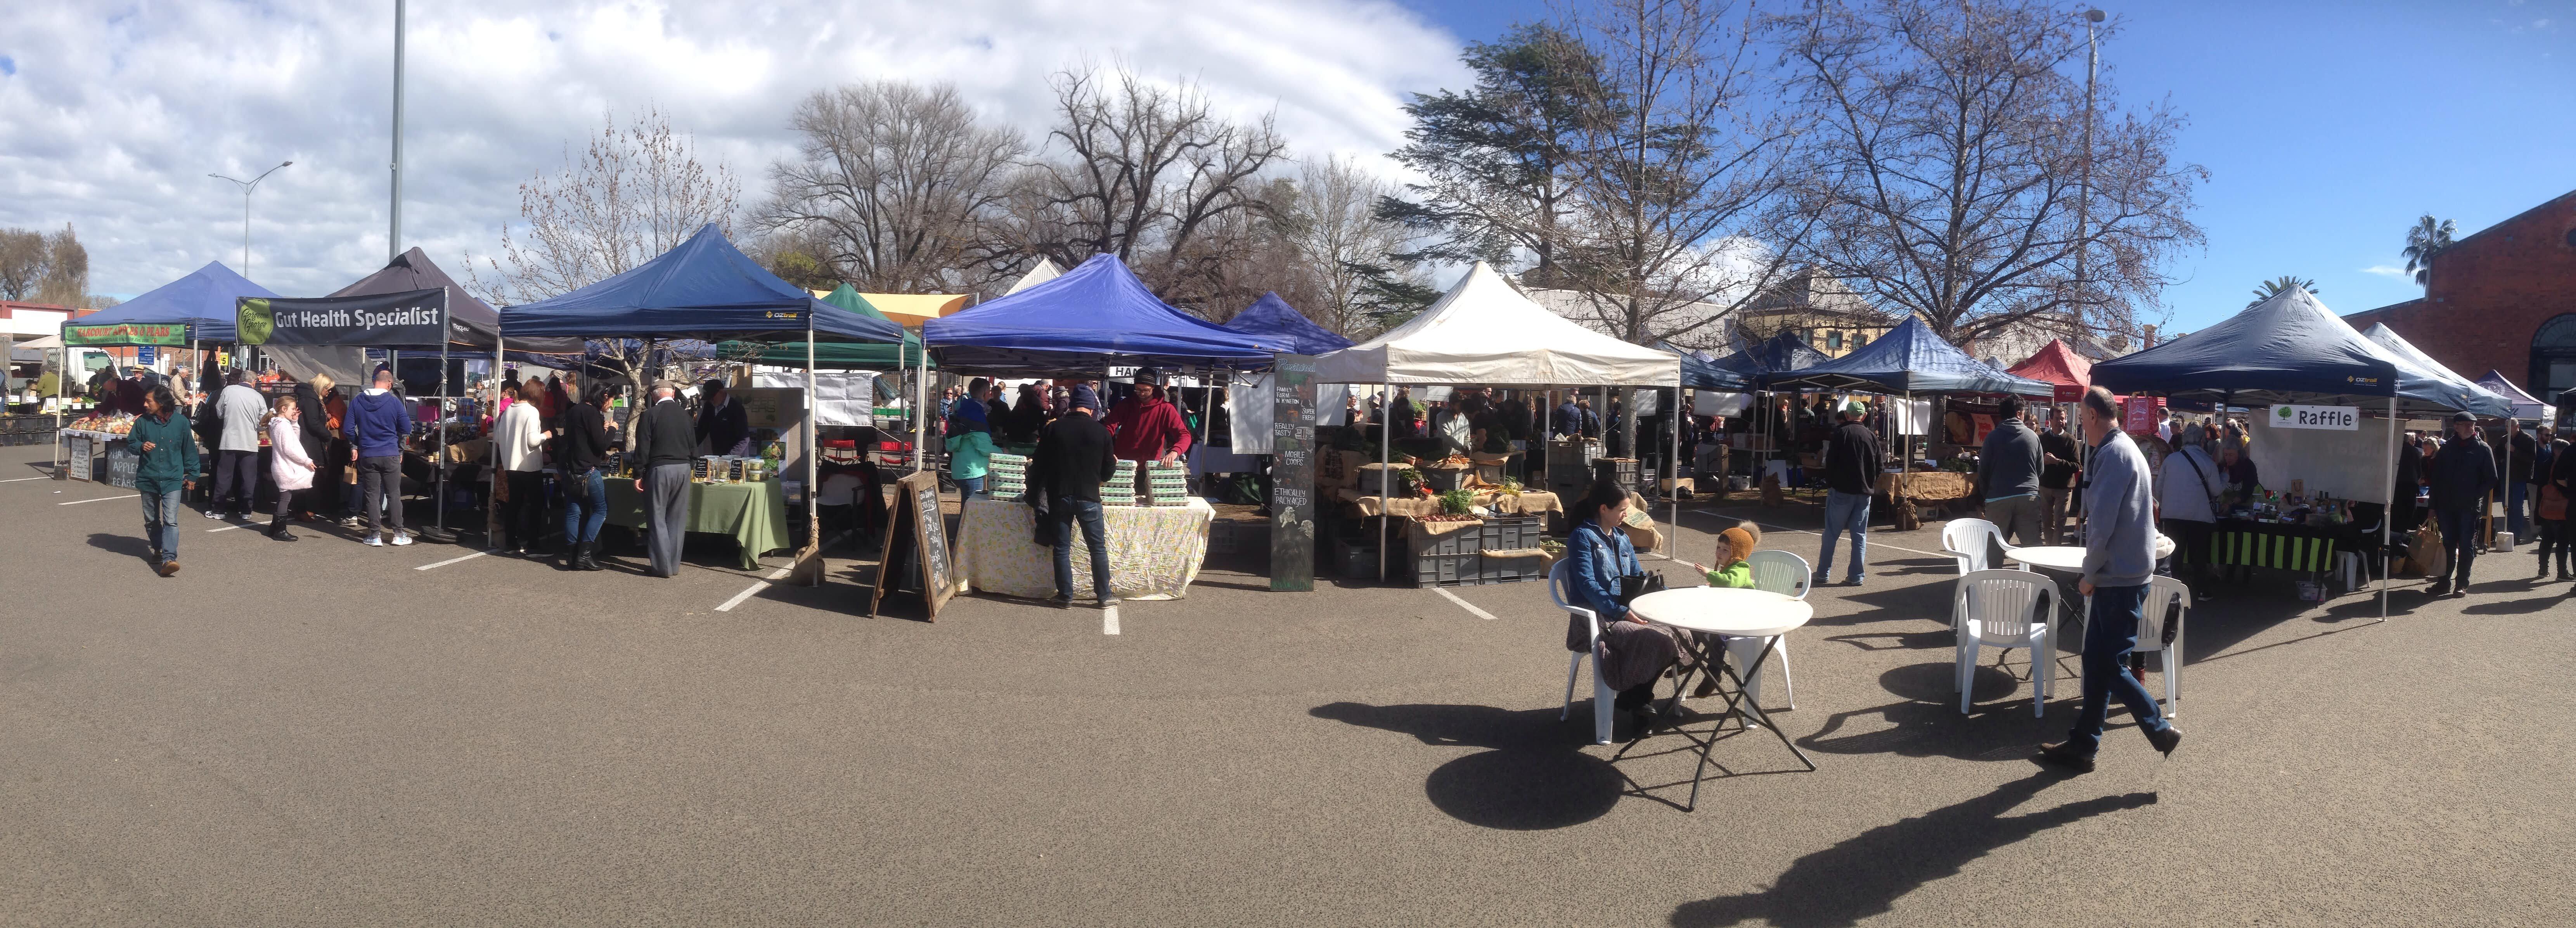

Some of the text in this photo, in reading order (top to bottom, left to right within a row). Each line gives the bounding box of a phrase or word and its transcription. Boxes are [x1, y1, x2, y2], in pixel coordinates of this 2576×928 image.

[241, 308, 269, 325] Gorgeous
[275, 307, 438, 330] Gut Health Specialist
[77, 327, 112, 336] HARCOURT
[146, 327, 170, 336] PEARS
[244, 319, 267, 335] George
[2299, 411, 2351, 426] Raffle
[113, 477, 136, 487] PEARS
[1274, 488, 1306, 497] ETHICALLY
[1275, 496, 1307, 507] PACKAGED
